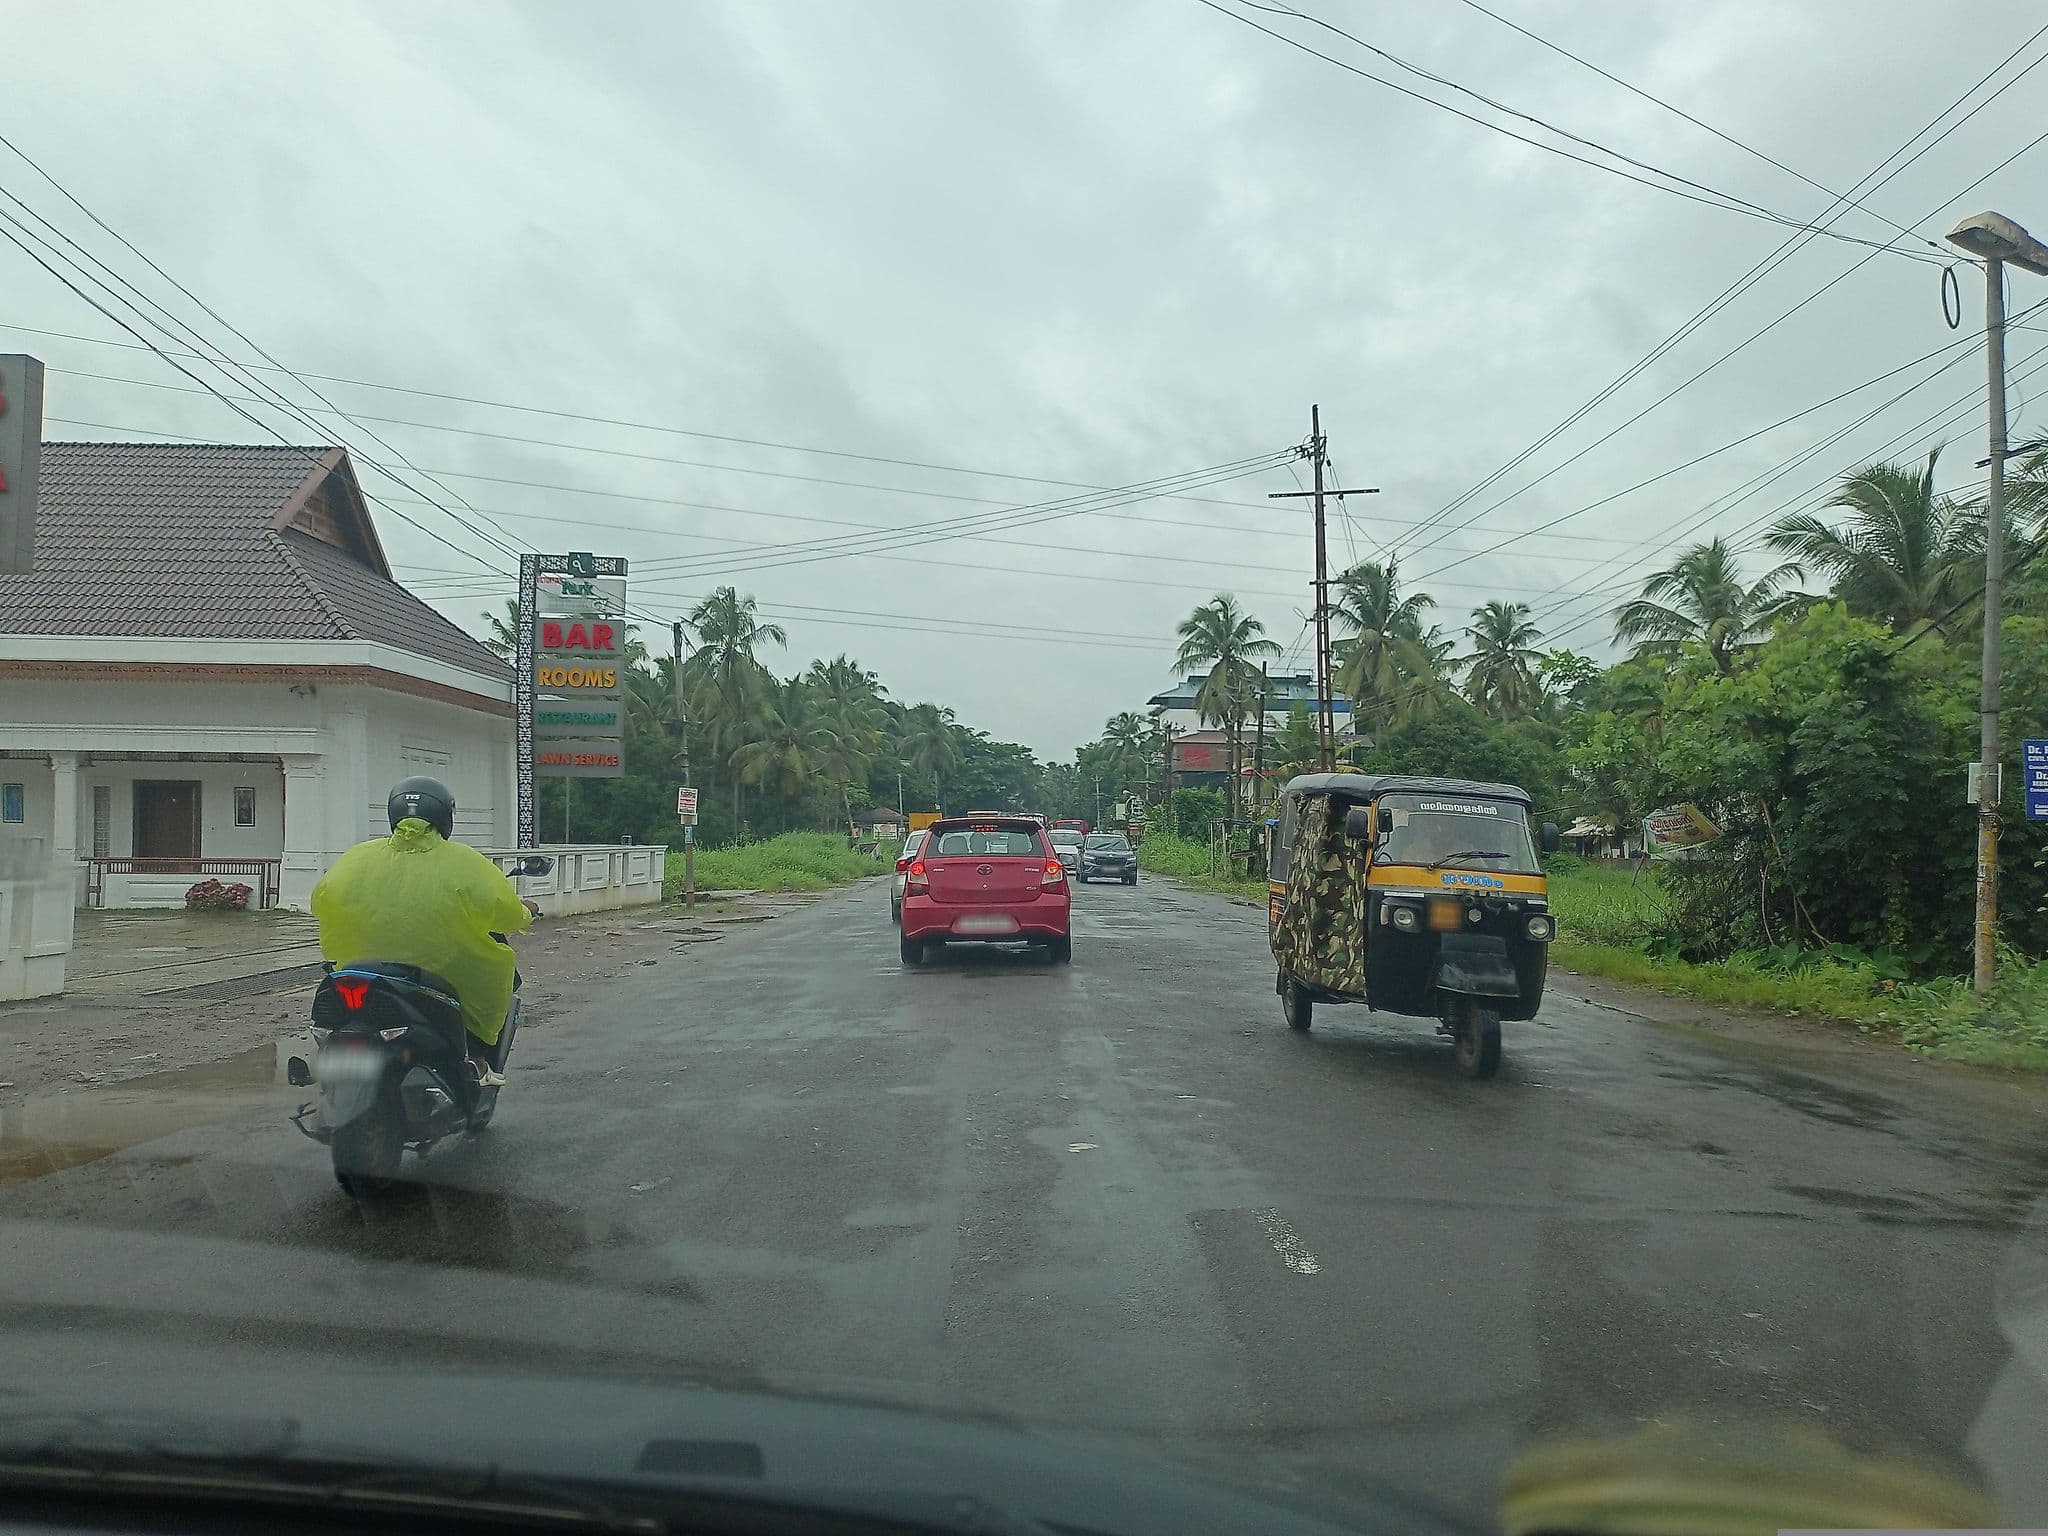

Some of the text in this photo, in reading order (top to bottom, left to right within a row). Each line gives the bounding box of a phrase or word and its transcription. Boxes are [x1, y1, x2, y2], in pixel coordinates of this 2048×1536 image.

[561, 581, 593, 595] Park
[542, 622, 614, 650] BAR
[538, 666, 616, 688] ROOMS
[2028, 746, 2042, 754] Dr.
[535, 752, 618, 767] LAWN SERVICE
